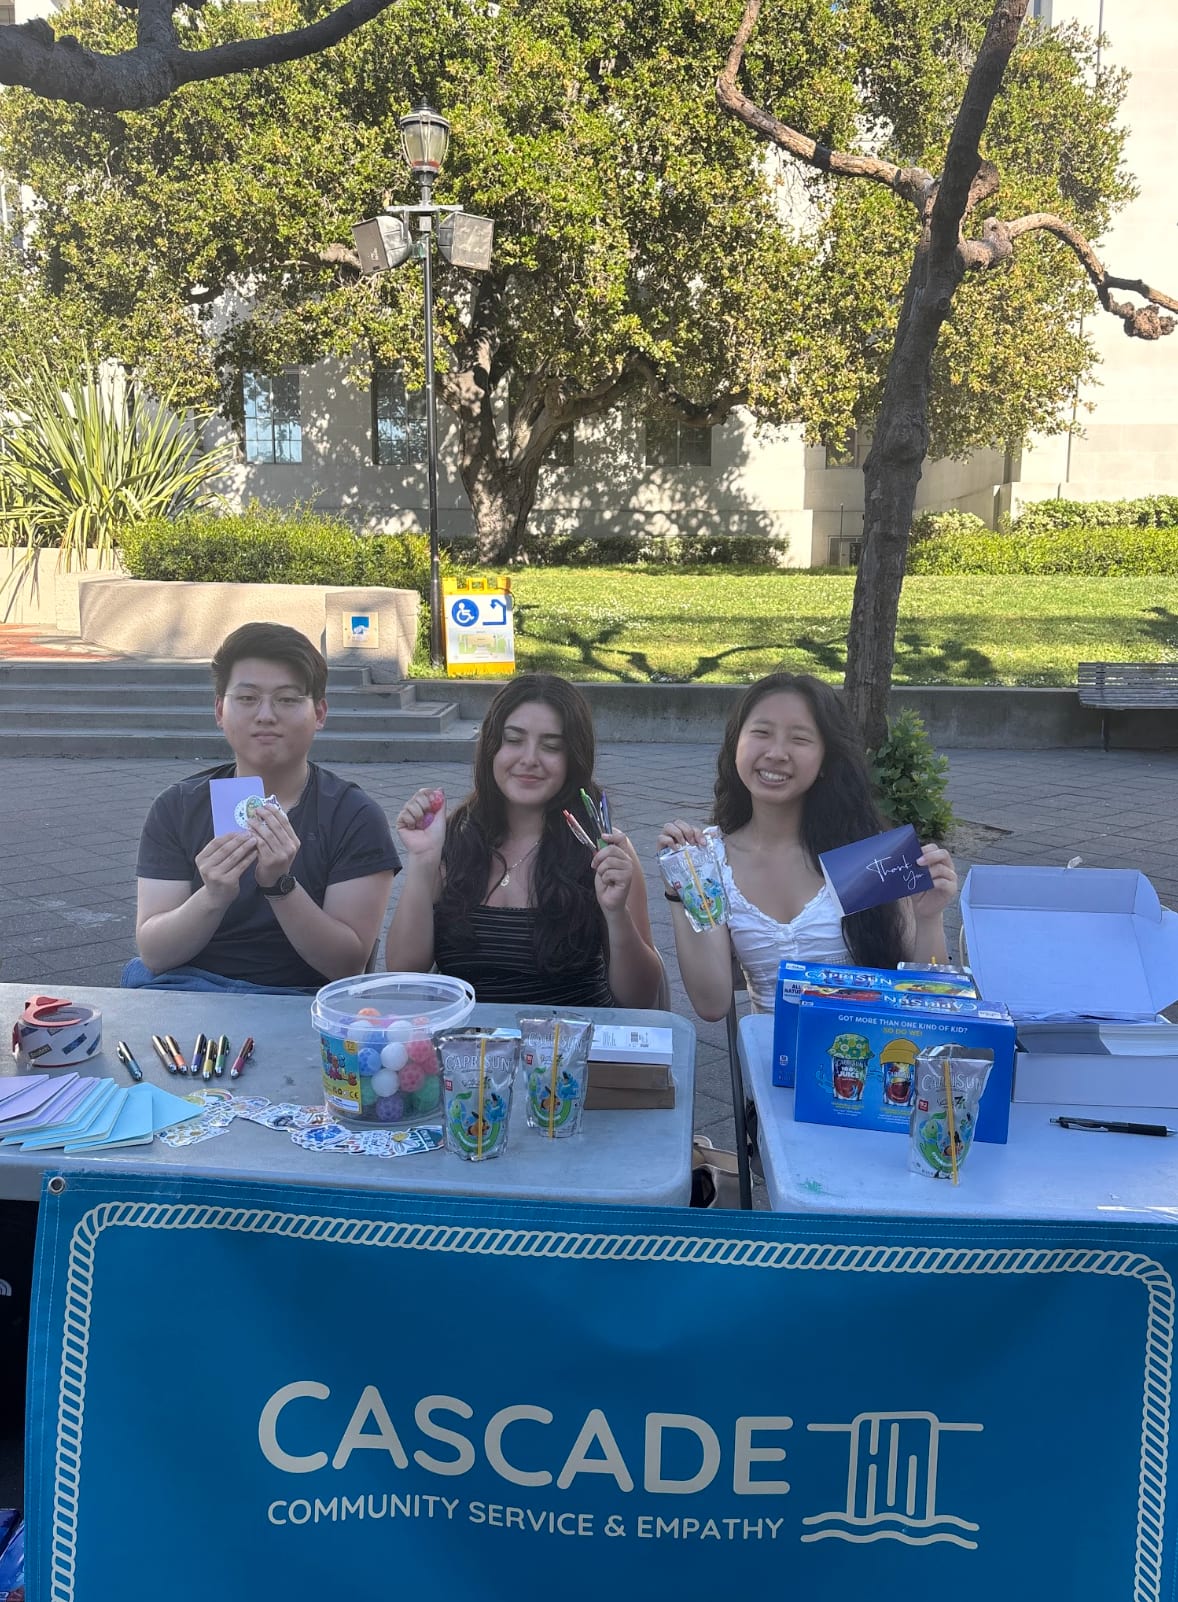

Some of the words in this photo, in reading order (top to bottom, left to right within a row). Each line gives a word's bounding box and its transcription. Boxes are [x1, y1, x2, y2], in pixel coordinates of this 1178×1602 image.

[865, 854, 913, 883] Thank
[855, 1016, 878, 1024] MORE
[880, 1019, 900, 1027] THAN
[918, 1023, 937, 1031] KIND
[950, 1026, 968, 1034] KID?
[445, 1055, 512, 1073] CAPRSUN
[837, 1071, 860, 1079] JUICE
[258, 1380, 794, 1495] CASCADE
[267, 1494, 460, 1525] COMMUNITY
[468, 1501, 594, 1536] SERVICE
[604, 1515, 627, 1537] &
[637, 1516, 784, 1540] EMPATHY
